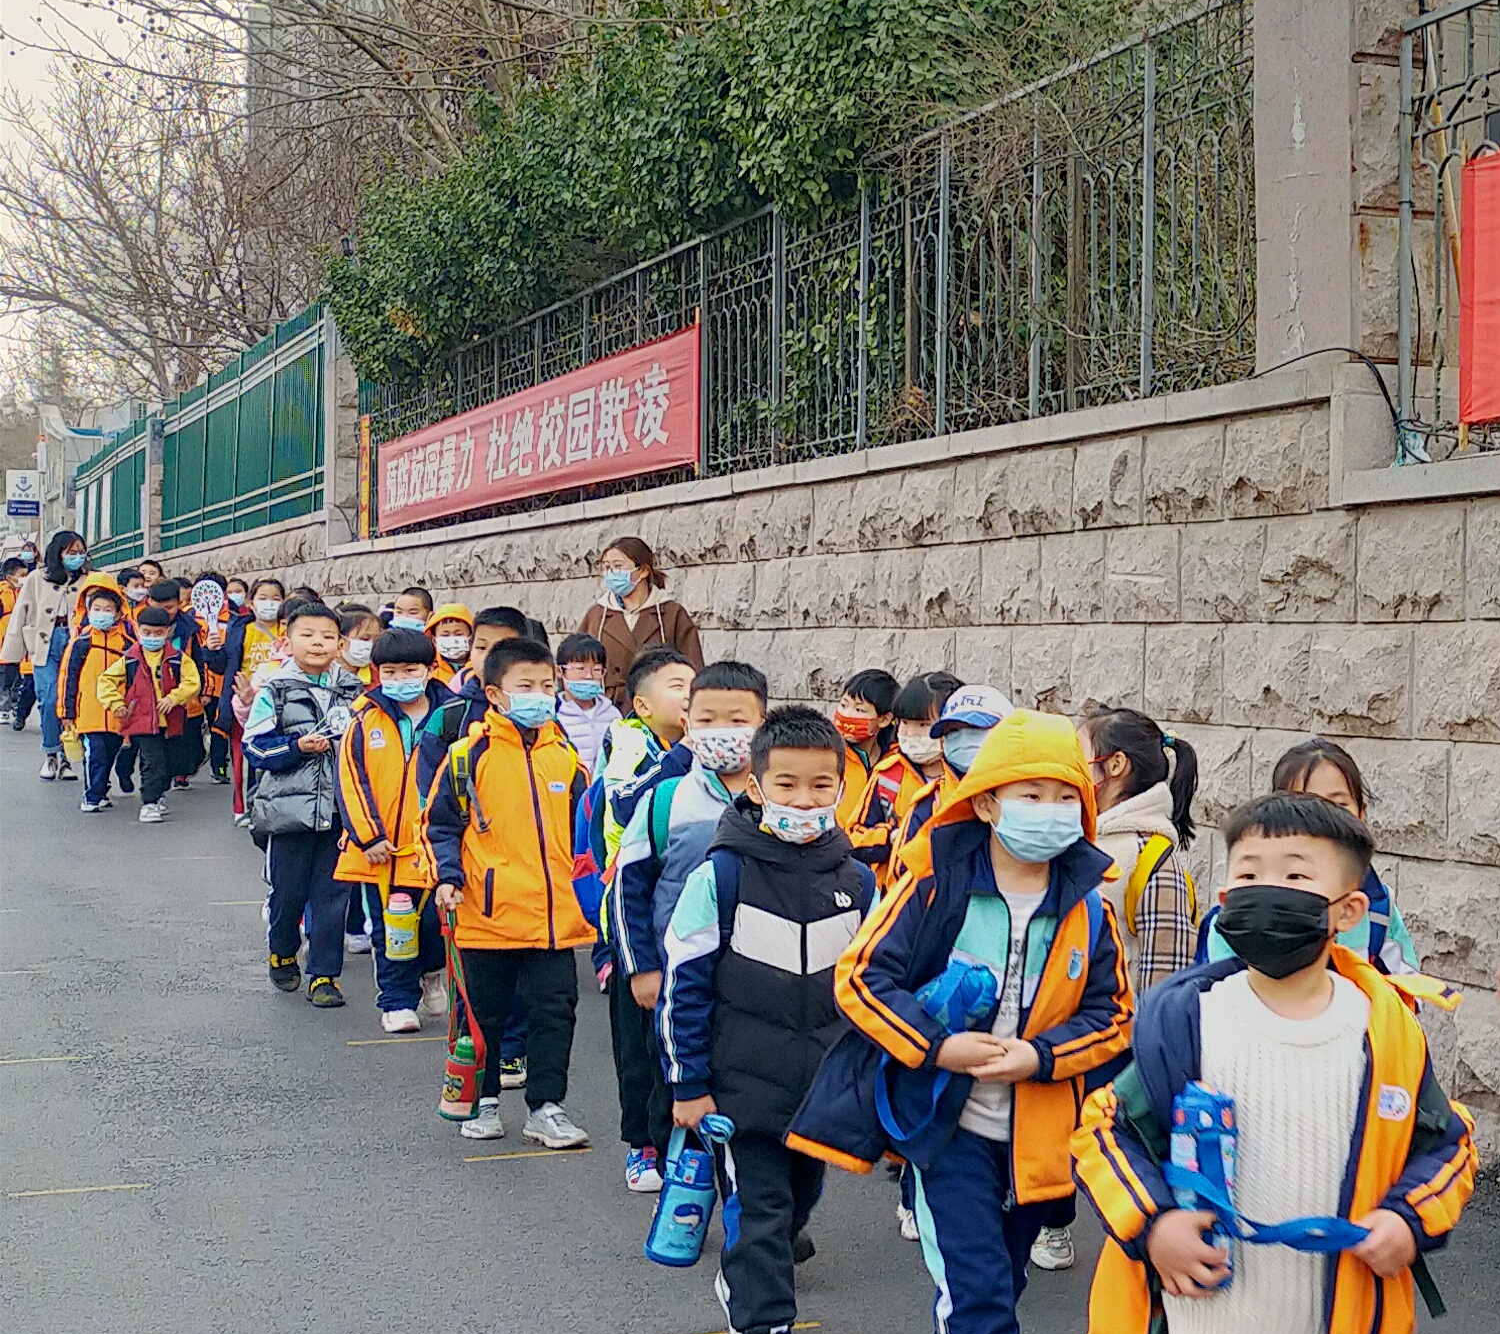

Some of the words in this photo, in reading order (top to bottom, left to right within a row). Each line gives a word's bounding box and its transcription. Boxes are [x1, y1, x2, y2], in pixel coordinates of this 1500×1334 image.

[486, 362, 670, 485] 杜绝校园欺凌
